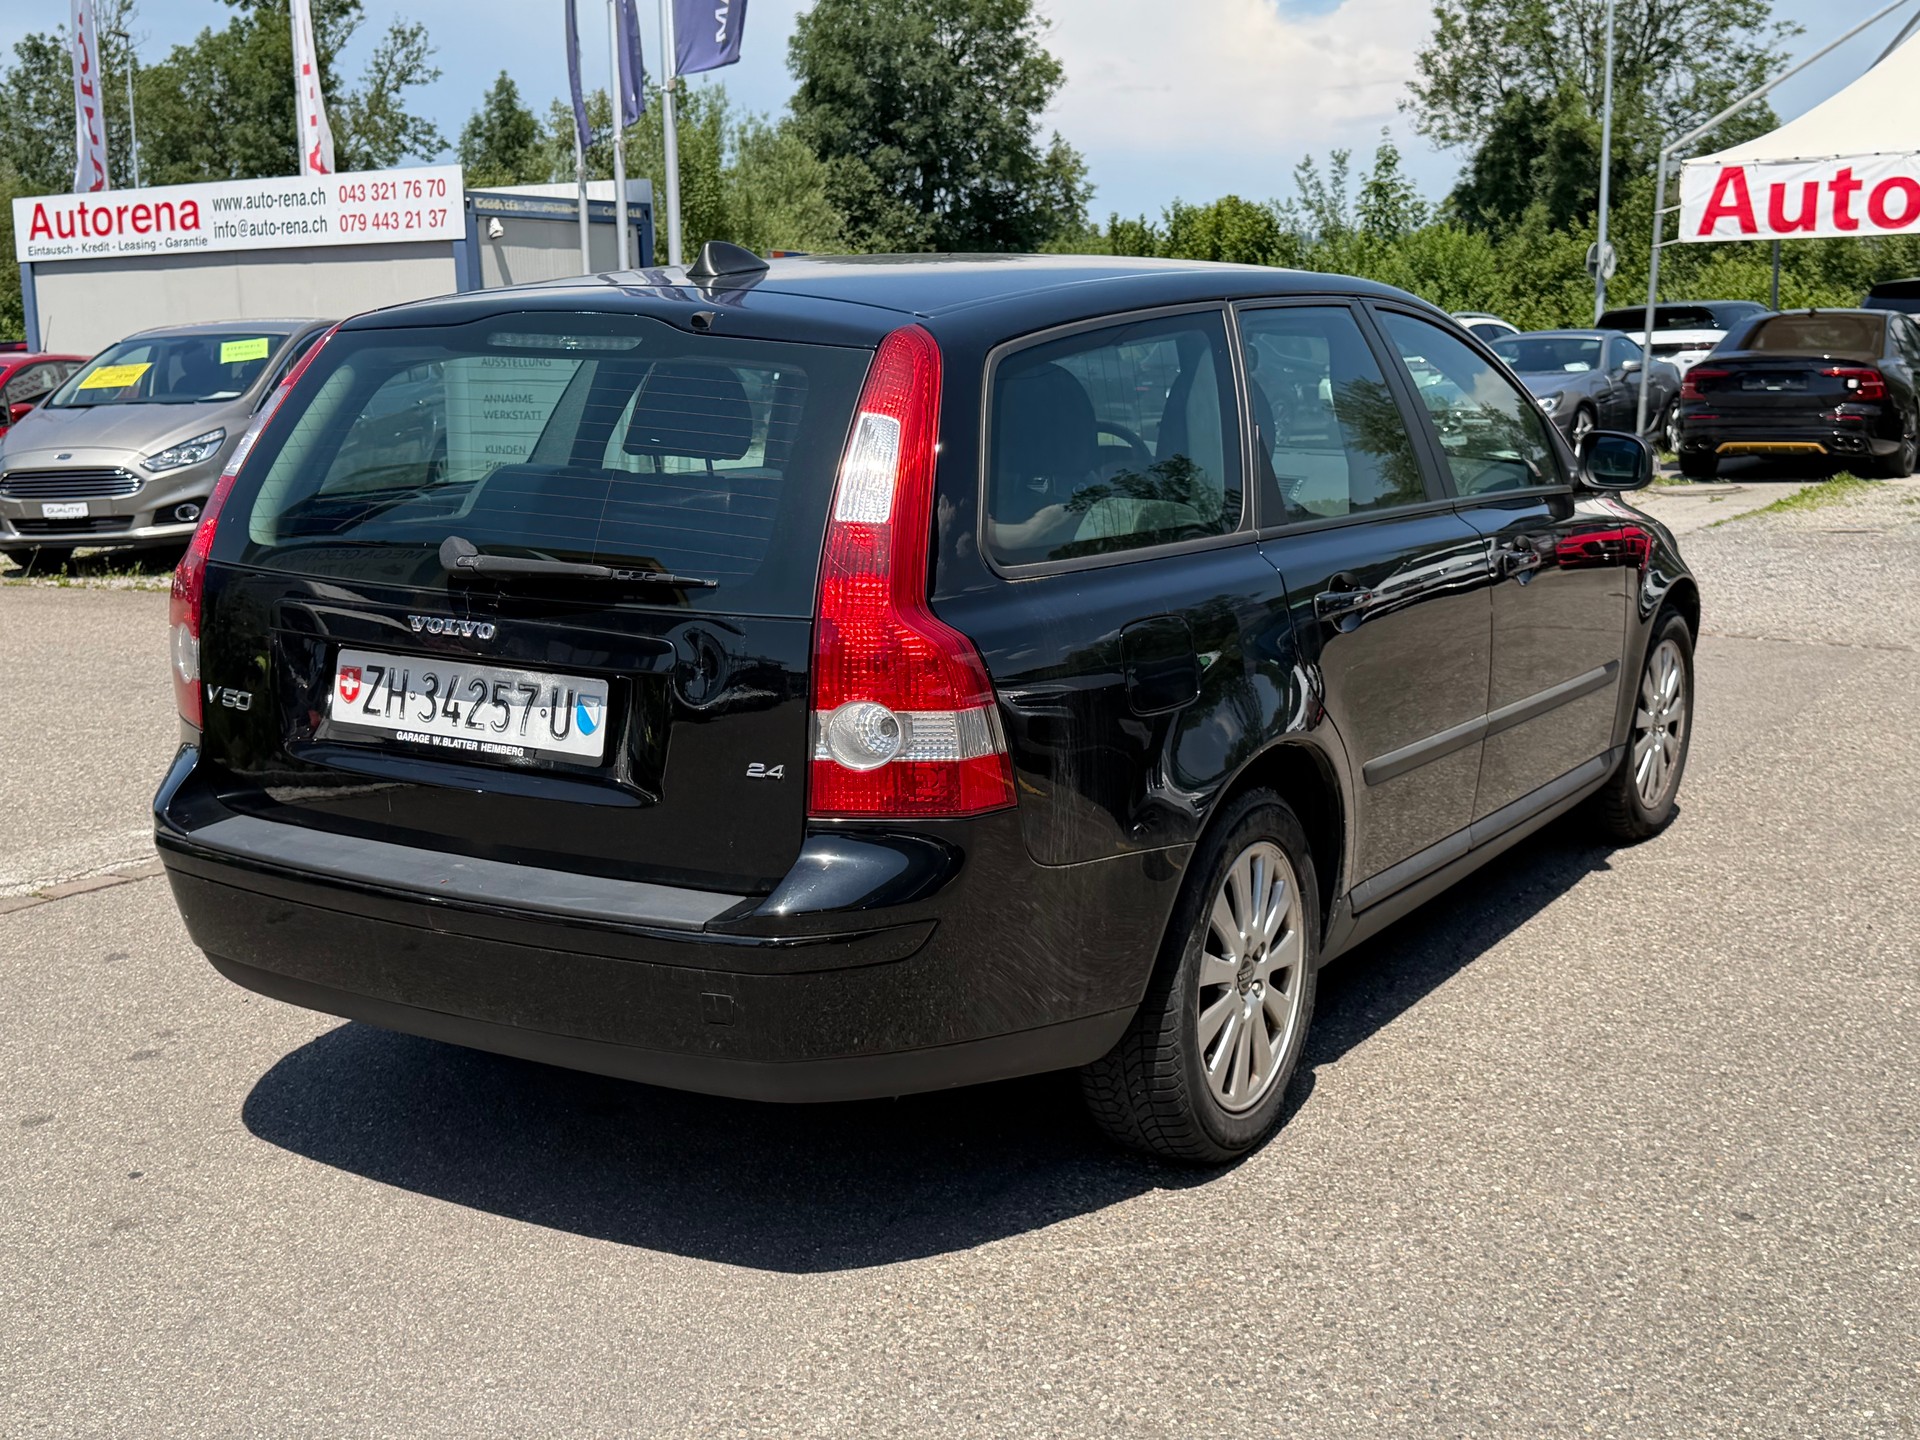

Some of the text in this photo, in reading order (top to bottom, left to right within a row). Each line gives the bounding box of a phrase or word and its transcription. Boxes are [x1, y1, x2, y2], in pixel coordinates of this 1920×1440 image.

[212, 187, 326, 211] www.auto-rena.ch
[338, 178, 446, 203] 043 321 76 70
[1696, 166, 1920, 236] Auto
[29, 199, 201, 241] Autorena
[213, 215, 328, 239] info@auto-rena.ch
[339, 208, 447, 232] 079 443 21 37
[27, 235, 208, 257] Eintausch Kredit Leasing Garantie
[481, 357, 552, 367] AUSSTELLUNG
[483, 394, 534, 404] ANNAHME
[483, 410, 542, 420] WERKSTATT
[485, 444, 526, 454] KUNDEN
[407, 614, 496, 640] VOLVO
[207, 683, 252, 711] V50
[396, 731, 430, 745] GARAGE
[481, 742, 524, 757] HEIMBERG
